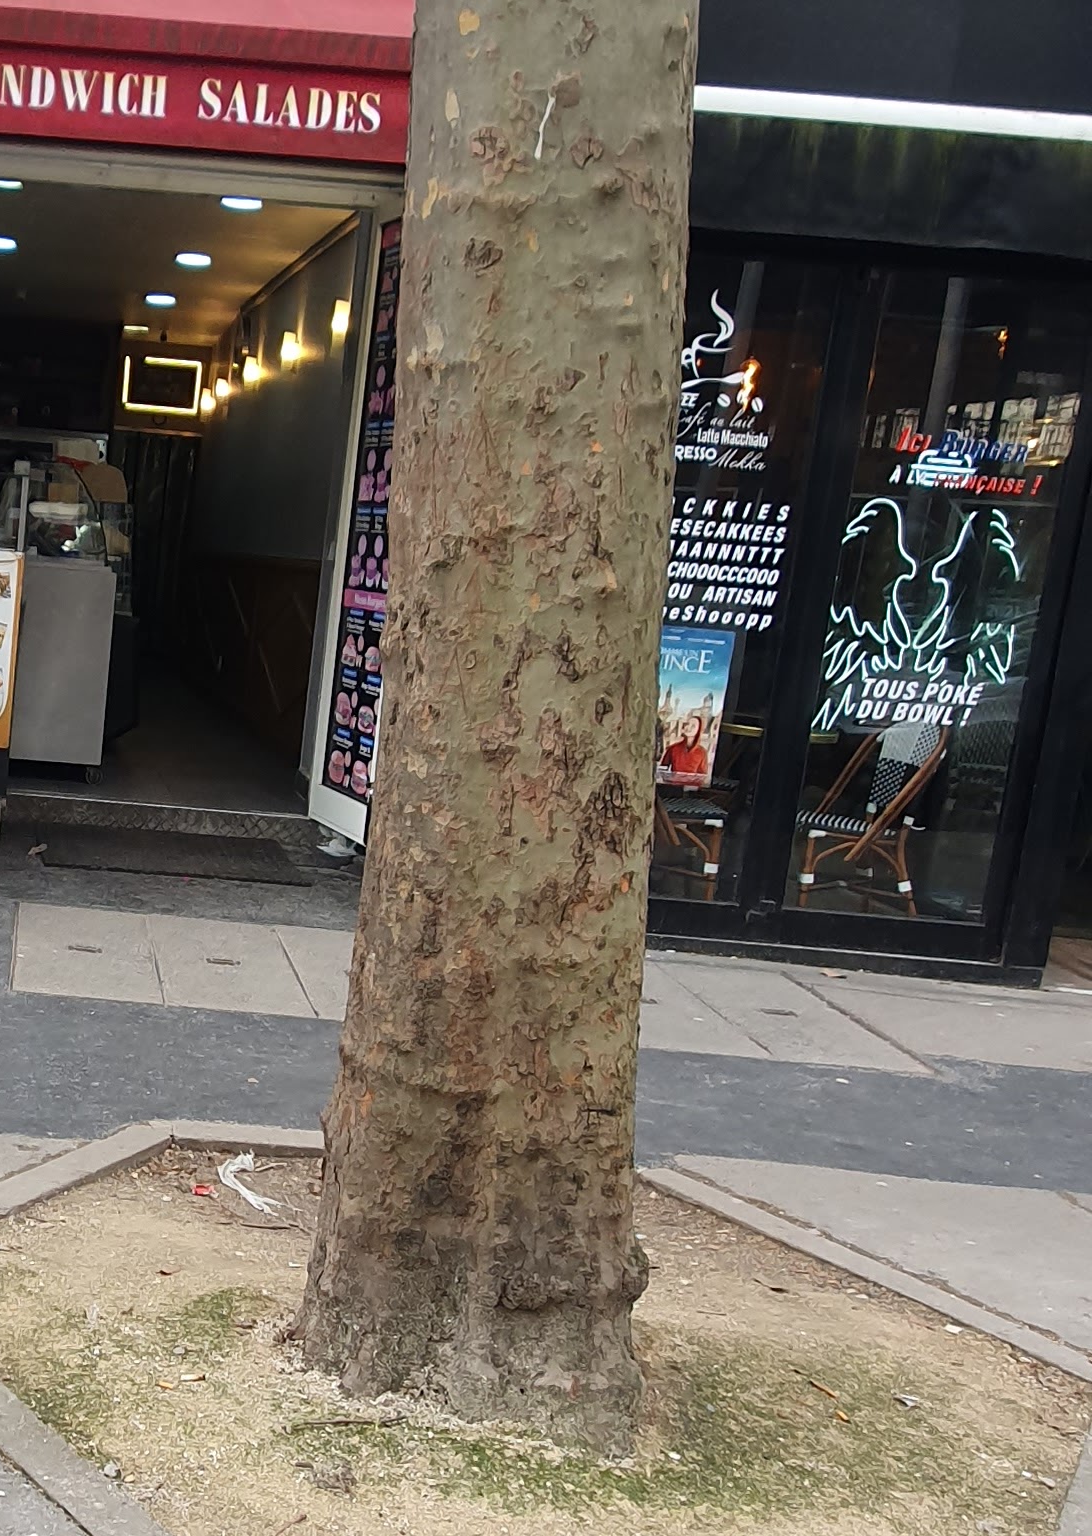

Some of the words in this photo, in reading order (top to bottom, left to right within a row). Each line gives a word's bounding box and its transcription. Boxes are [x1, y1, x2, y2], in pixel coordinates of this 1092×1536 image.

[198, 78, 382, 134] SALADES
[681, 392, 699, 407] EE
[697, 427, 719, 445] Latte
[721, 430, 769, 448] Macchiato
[675, 444, 717, 461] RESSO
[672, 496, 790, 522] CKKIES
[670, 518, 787, 544] ESECAKKEES
[701, 585, 778, 607] ARTISAN
[662, 605, 773, 632] eShooopp
[661, 649, 714, 674] INCE
[861, 677, 918, 700] TOUS
[856, 699, 890, 720] DU
[892, 703, 953, 726] BOWL
[960, 707, 972, 727] !
